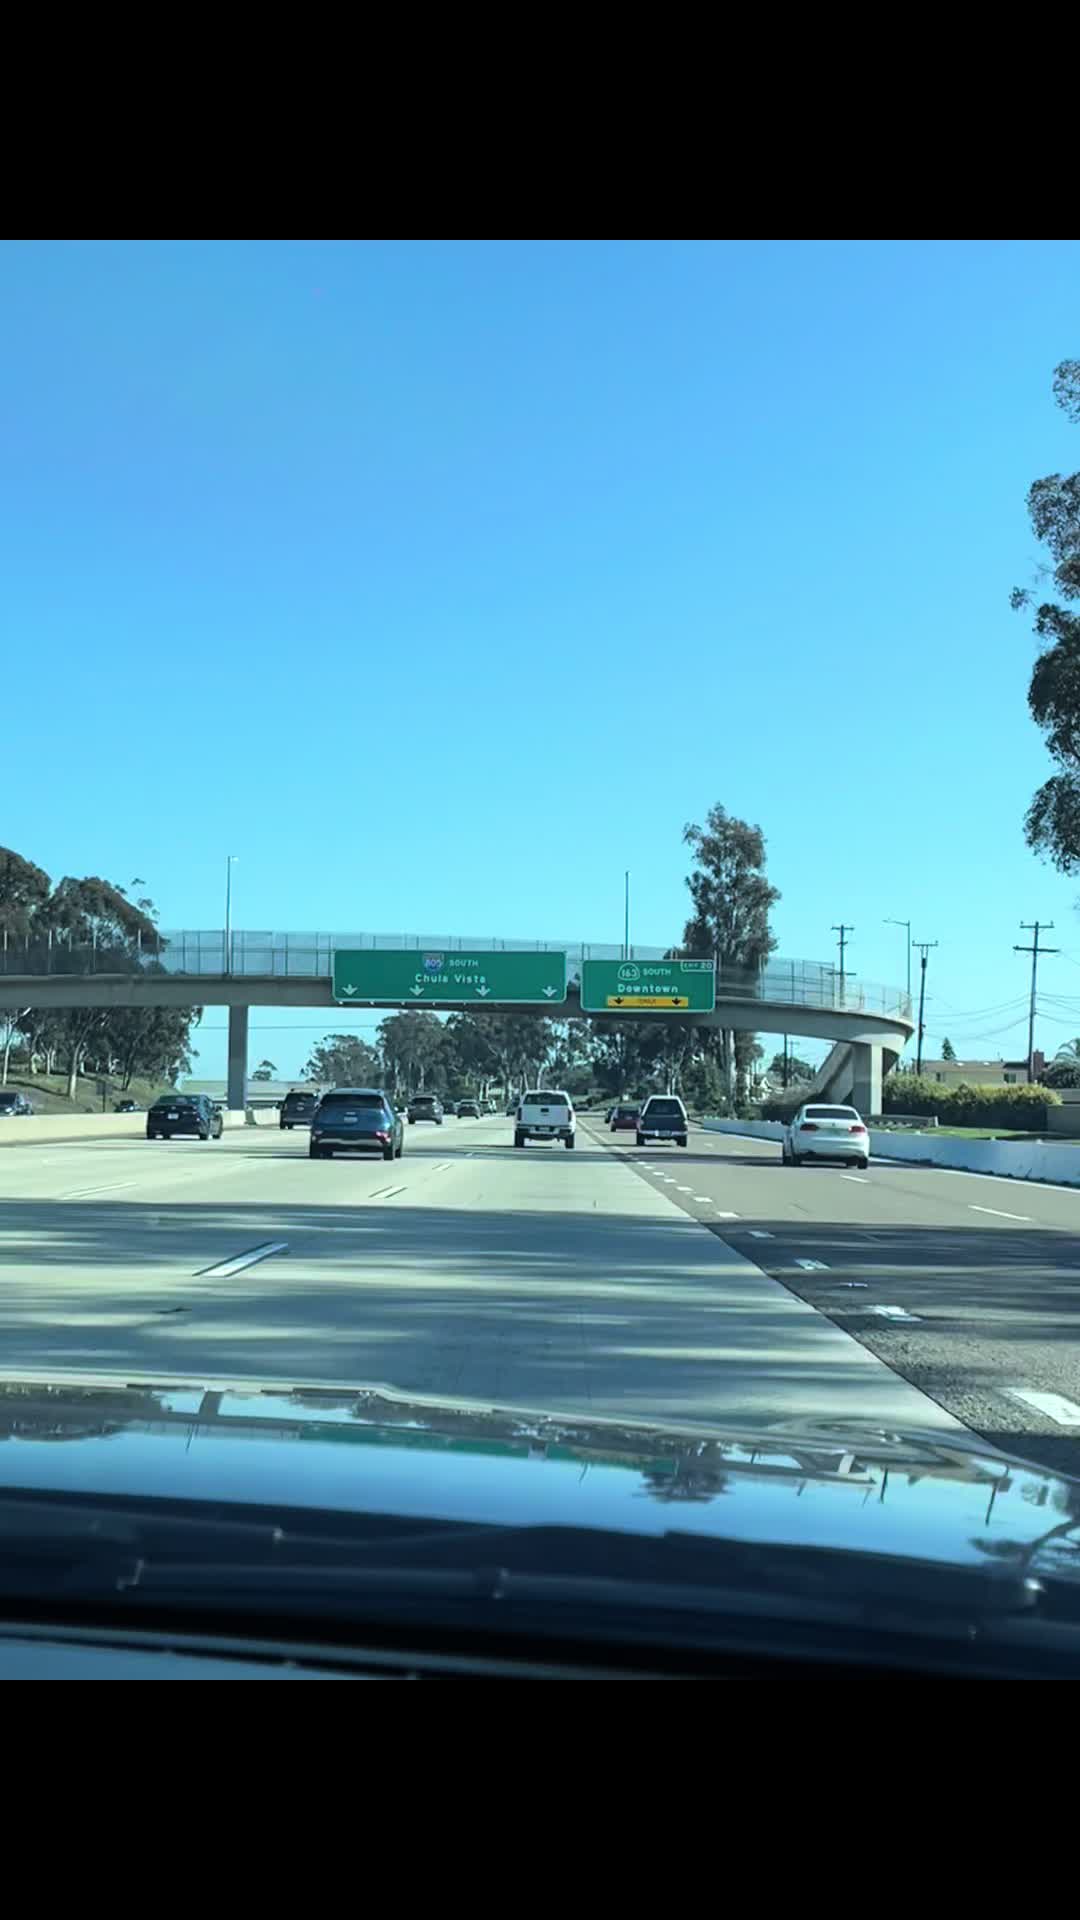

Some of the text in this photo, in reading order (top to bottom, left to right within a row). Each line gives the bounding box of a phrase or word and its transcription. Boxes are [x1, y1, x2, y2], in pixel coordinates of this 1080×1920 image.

[425, 959, 479, 968] 805 SOUTH
[622, 968, 671, 977] 163 SOUTH
[415, 974, 486, 983] Chula Vista
[617, 984, 678, 993] Downtown
